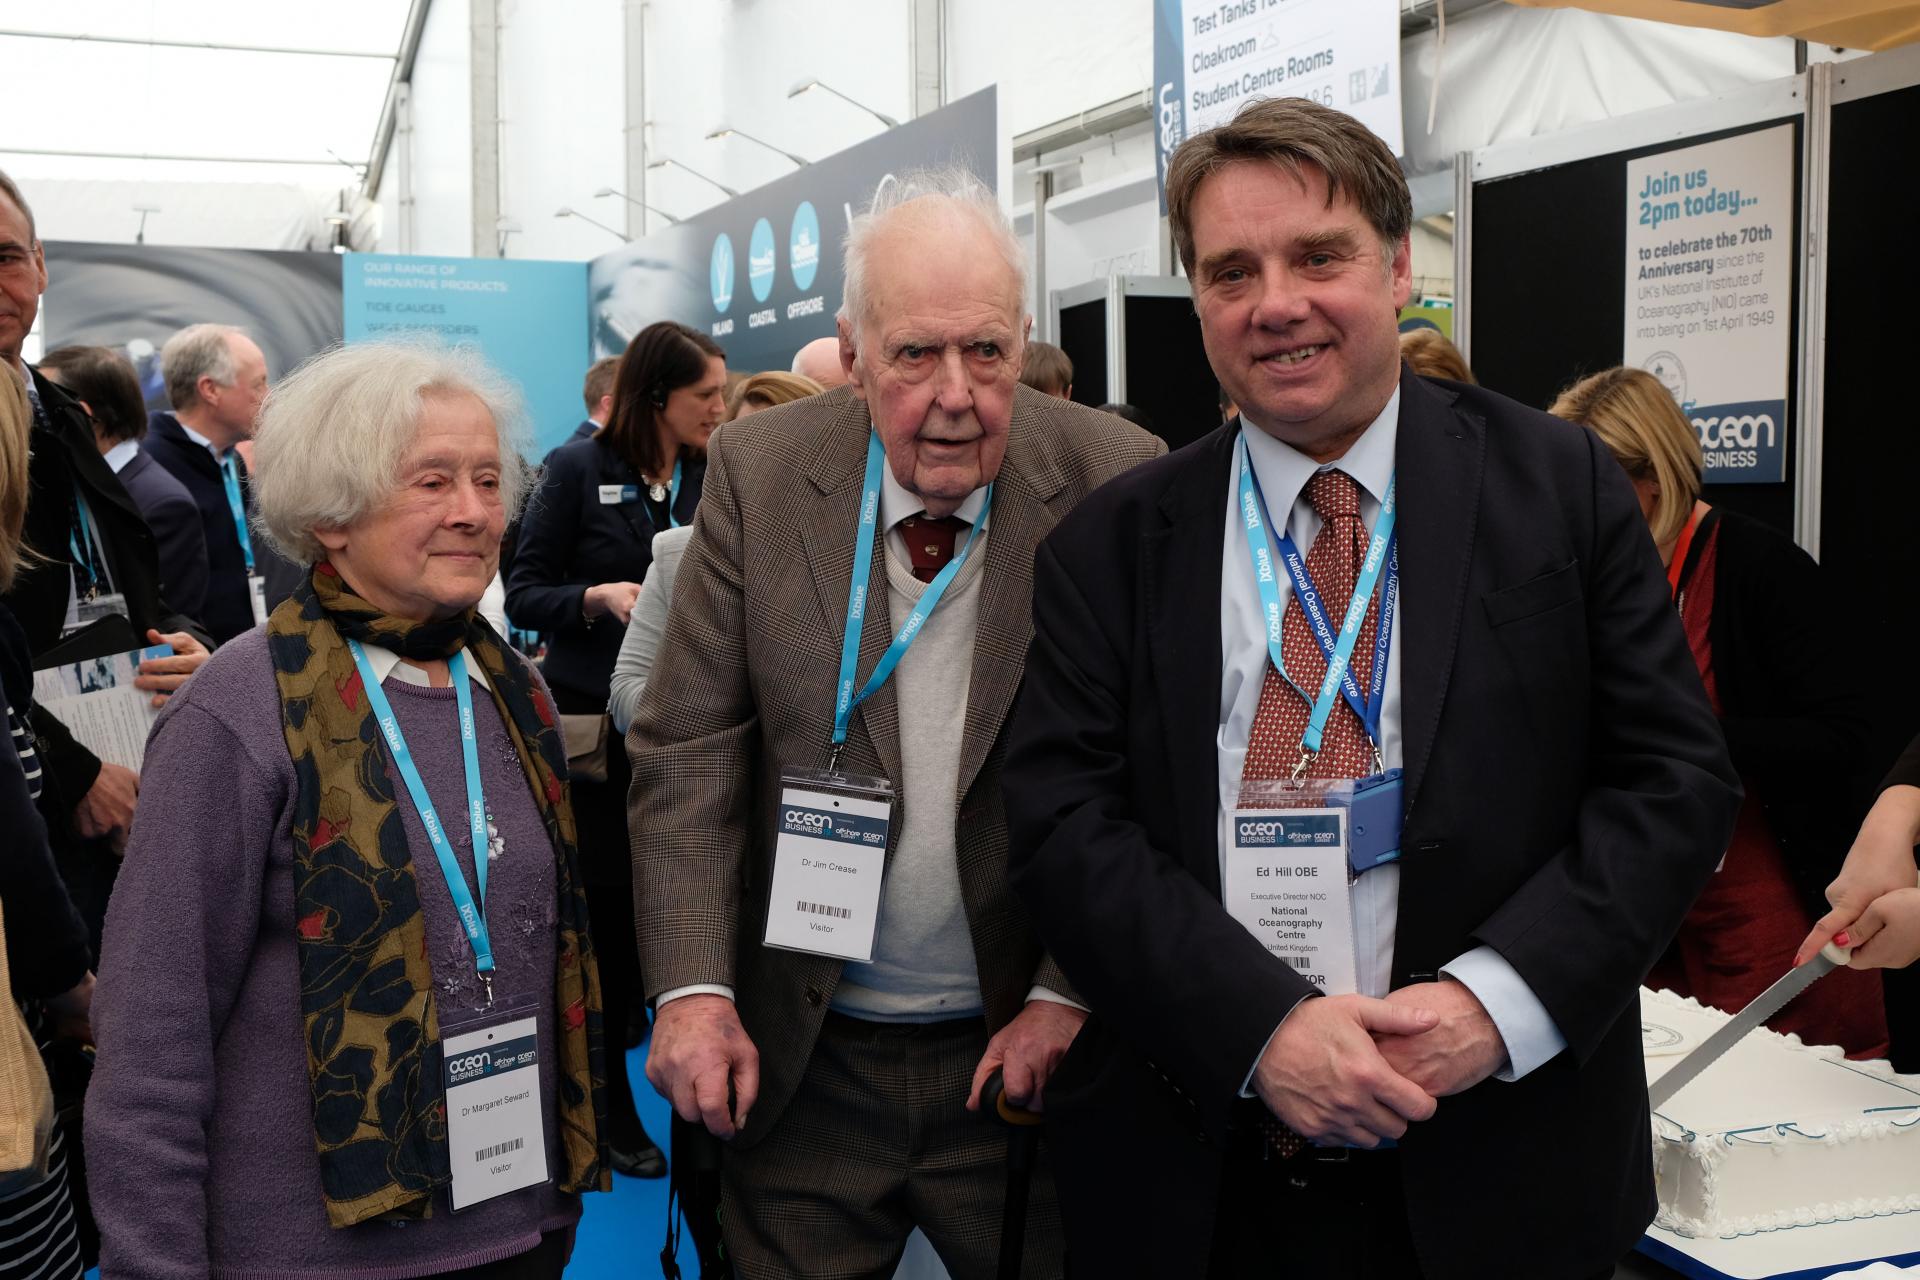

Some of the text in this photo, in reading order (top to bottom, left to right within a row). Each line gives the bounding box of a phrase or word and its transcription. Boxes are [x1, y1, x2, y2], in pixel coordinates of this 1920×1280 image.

[1192, 0, 1257, 36] Test Tanks
[1192, 37, 1257, 74] Cloakroom
[1192, 49, 1334, 112] Student Centre Rooms
[1639, 169, 1708, 200] Join us
[1639, 188, 1758, 230] 2pm today...
[1638, 224, 1773, 261] to celebrate the 70th
[364, 262, 457, 275] OUR RANGE OF
[1638, 250, 1765, 281] Anniversary since the
[365, 278, 508, 292] INNOVATIVE PRODUCTS
[1638, 269, 1763, 301] UK's National Institute of
[366, 302, 446, 314] TIDE GAUGES
[787, 296, 824, 320] OFFSHORE
[1637, 301, 1710, 320] Oceanography
[1739, 292, 1769, 307] came
[749, 308, 777, 328] COASTAL
[1636, 308, 1775, 339] into being on 1st April 1949
[711, 319, 734, 337] INLAND
[1692, 414, 1774, 449] ocean
[1703, 450, 1757, 468] SINESS
[1378, 573, 1399, 649] Oceanography
[1286, 552, 1311, 592] National
[1343, 670, 1359, 699] entre
[1373, 649, 1386, 696] National
[785, 810, 832, 829] ocean
[785, 822, 823, 835] BUSINESS
[1240, 822, 1284, 837] ocean
[1240, 836, 1276, 844] BUSINESS
[802, 858, 857, 875] Dr Jim Crease
[1256, 866, 1318, 877] Ed Hill OBE
[1250, 893, 1327, 901] Executive Director NOC
[1271, 906, 1308, 916] National
[810, 923, 834, 934] Visitor
[1258, 918, 1323, 929] Oceanography
[1276, 930, 1306, 940] Centre
[1289, 944, 1319, 953] Kingdom
[449, 1051, 491, 1074] ocean
[450, 1067, 484, 1083] BUSINESS
[461, 1091, 530, 1117] Dr Margaret Seward
[490, 1163, 512, 1176] Visitor
